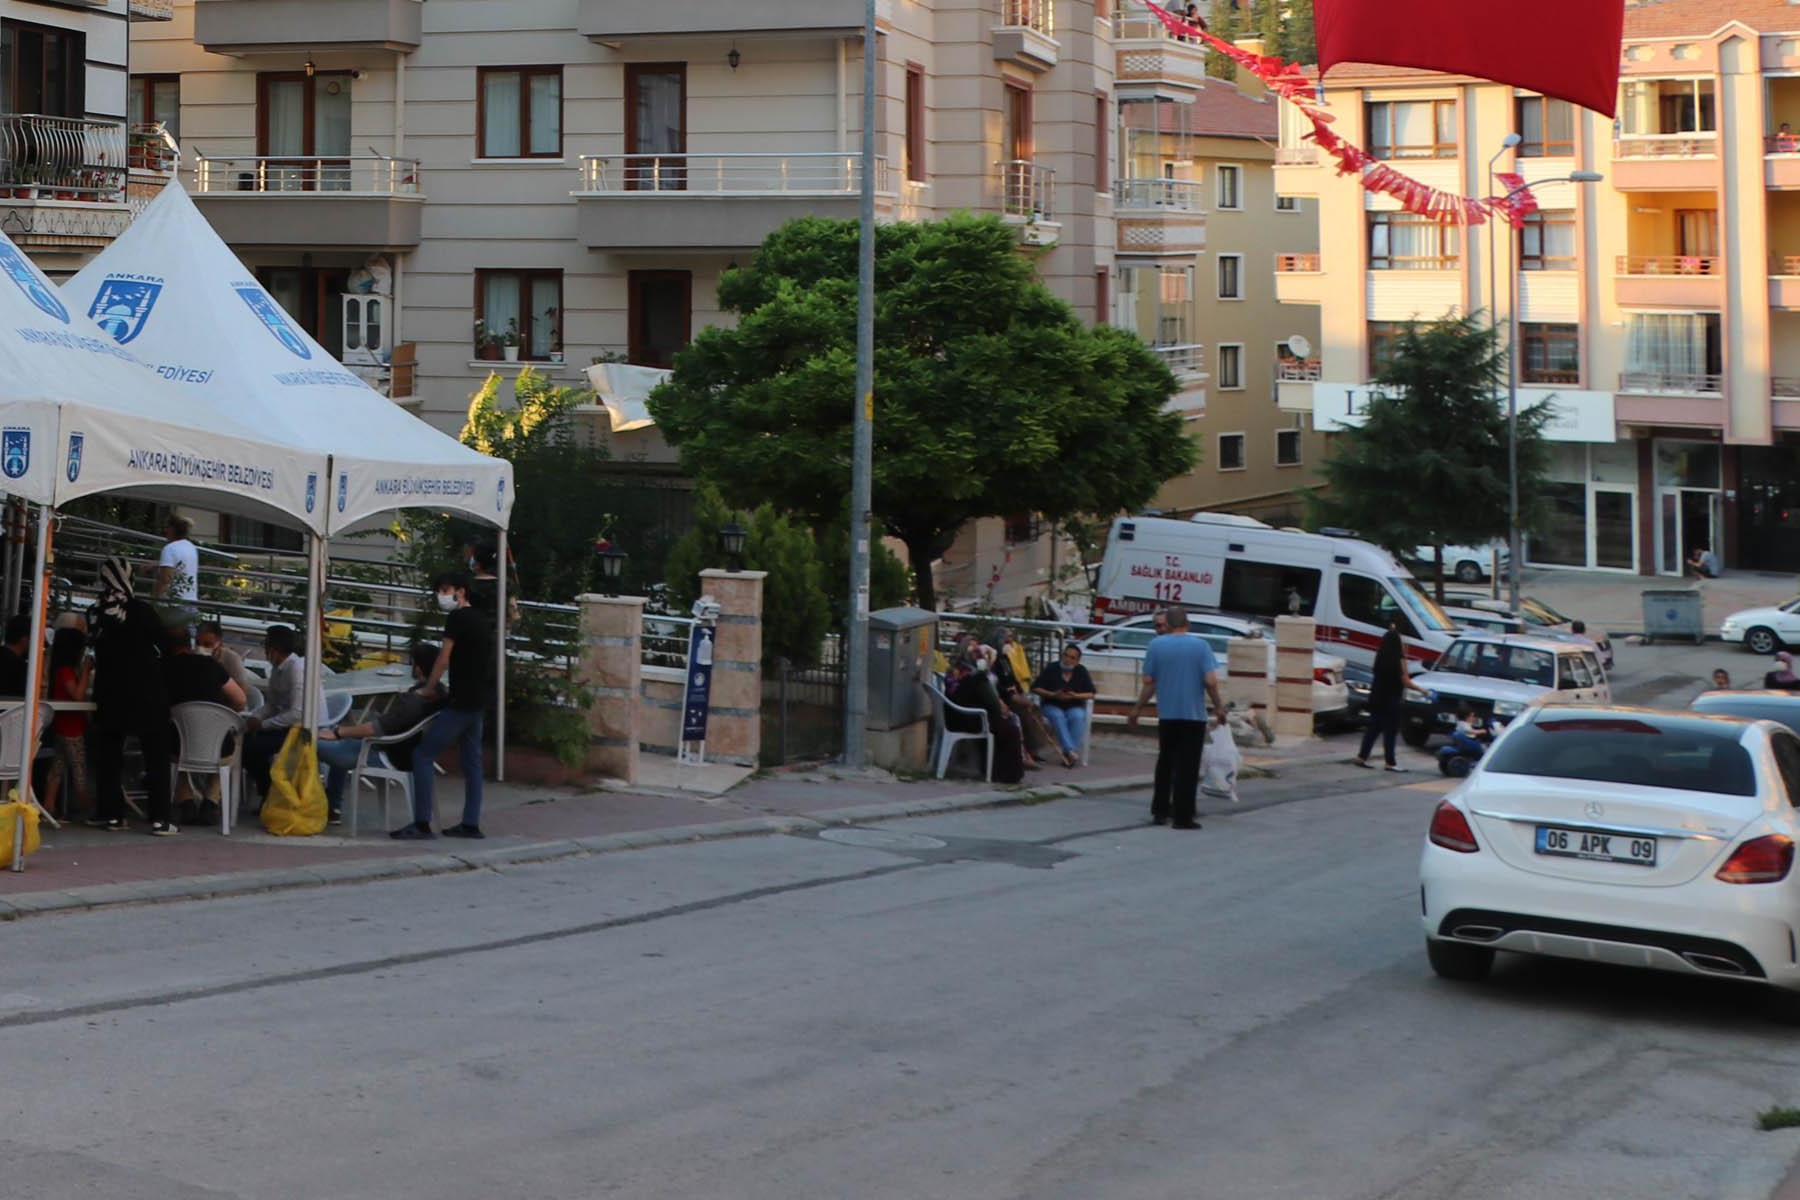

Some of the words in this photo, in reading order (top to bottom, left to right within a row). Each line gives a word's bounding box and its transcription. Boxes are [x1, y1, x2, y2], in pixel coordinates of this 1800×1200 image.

[104, 272, 166, 284] ANKARA
[155, 365, 215, 386] EDİYESİ
[127, 450, 168, 472] ANKARA
[1154, 581, 1183, 601] 112
[1547, 831, 1568, 849] 06
[1580, 834, 1611, 855] APK
[1631, 840, 1652, 858] 09
